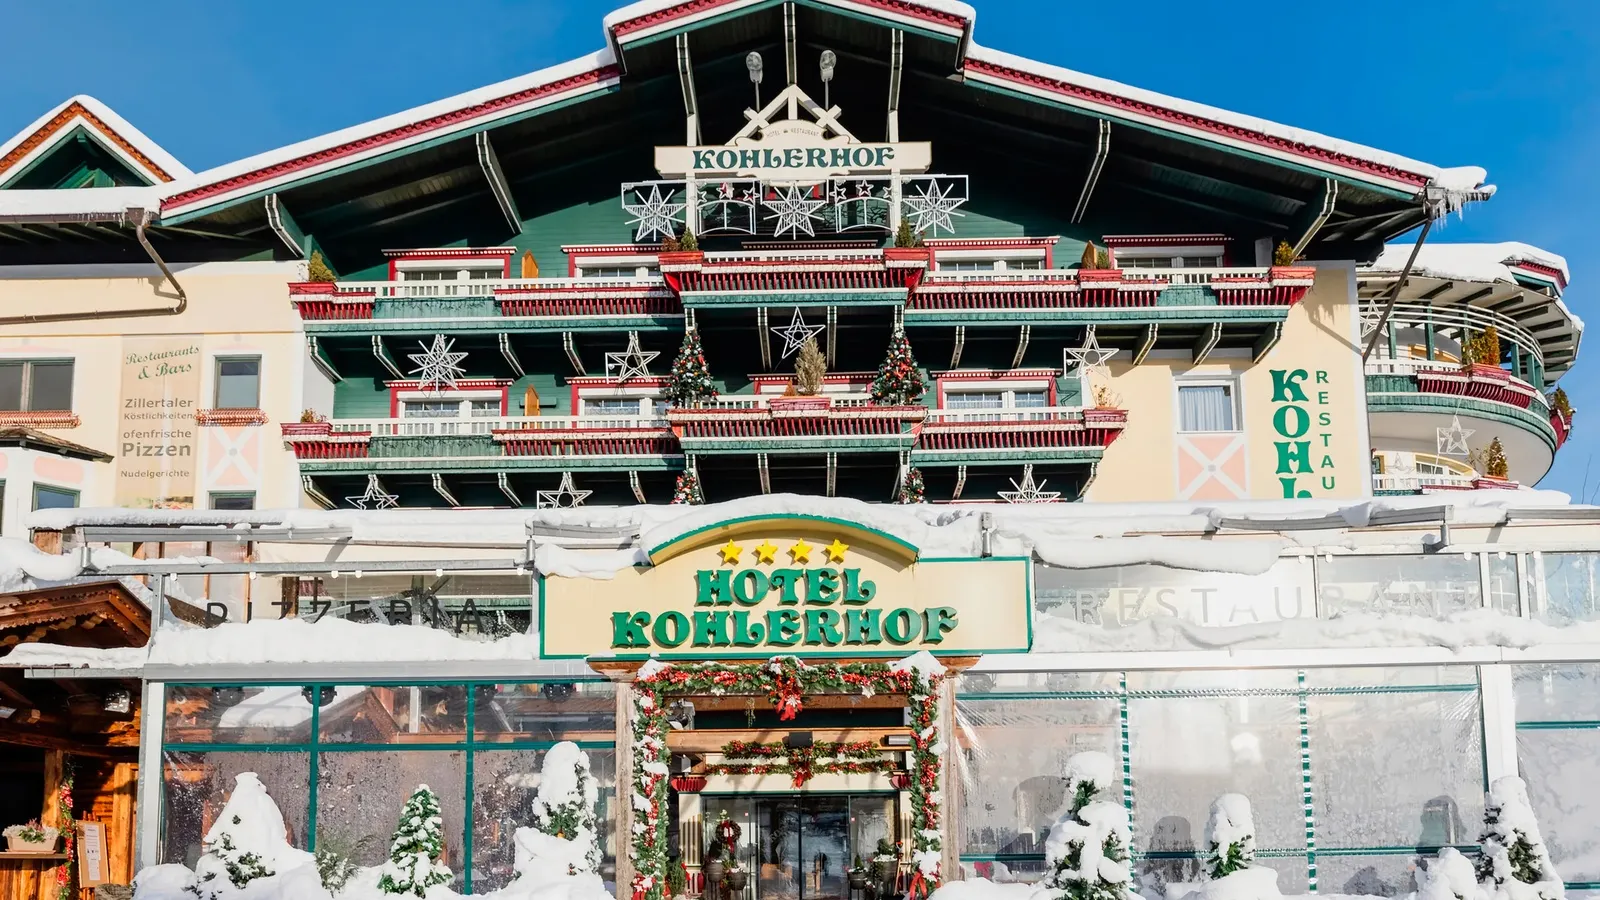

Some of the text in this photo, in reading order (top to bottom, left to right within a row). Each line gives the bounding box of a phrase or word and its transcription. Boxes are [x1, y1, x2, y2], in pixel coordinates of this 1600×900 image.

[692, 147, 895, 170] KOHLERHOF
[125, 345, 200, 365] Restaurants
[138, 362, 192, 380] & Bars
[124, 398, 194, 409] Zillertaler
[123, 412, 194, 421] Köstlichkeiten
[122, 428, 192, 440] ofenfrische
[1315, 370, 1335, 490] RESTAU
[122, 442, 191, 457] Pizzen
[120, 470, 190, 480] Nudelgerichte
[696, 567, 877, 607] HOTEL
[611, 605, 959, 648] KOHLERHOF
